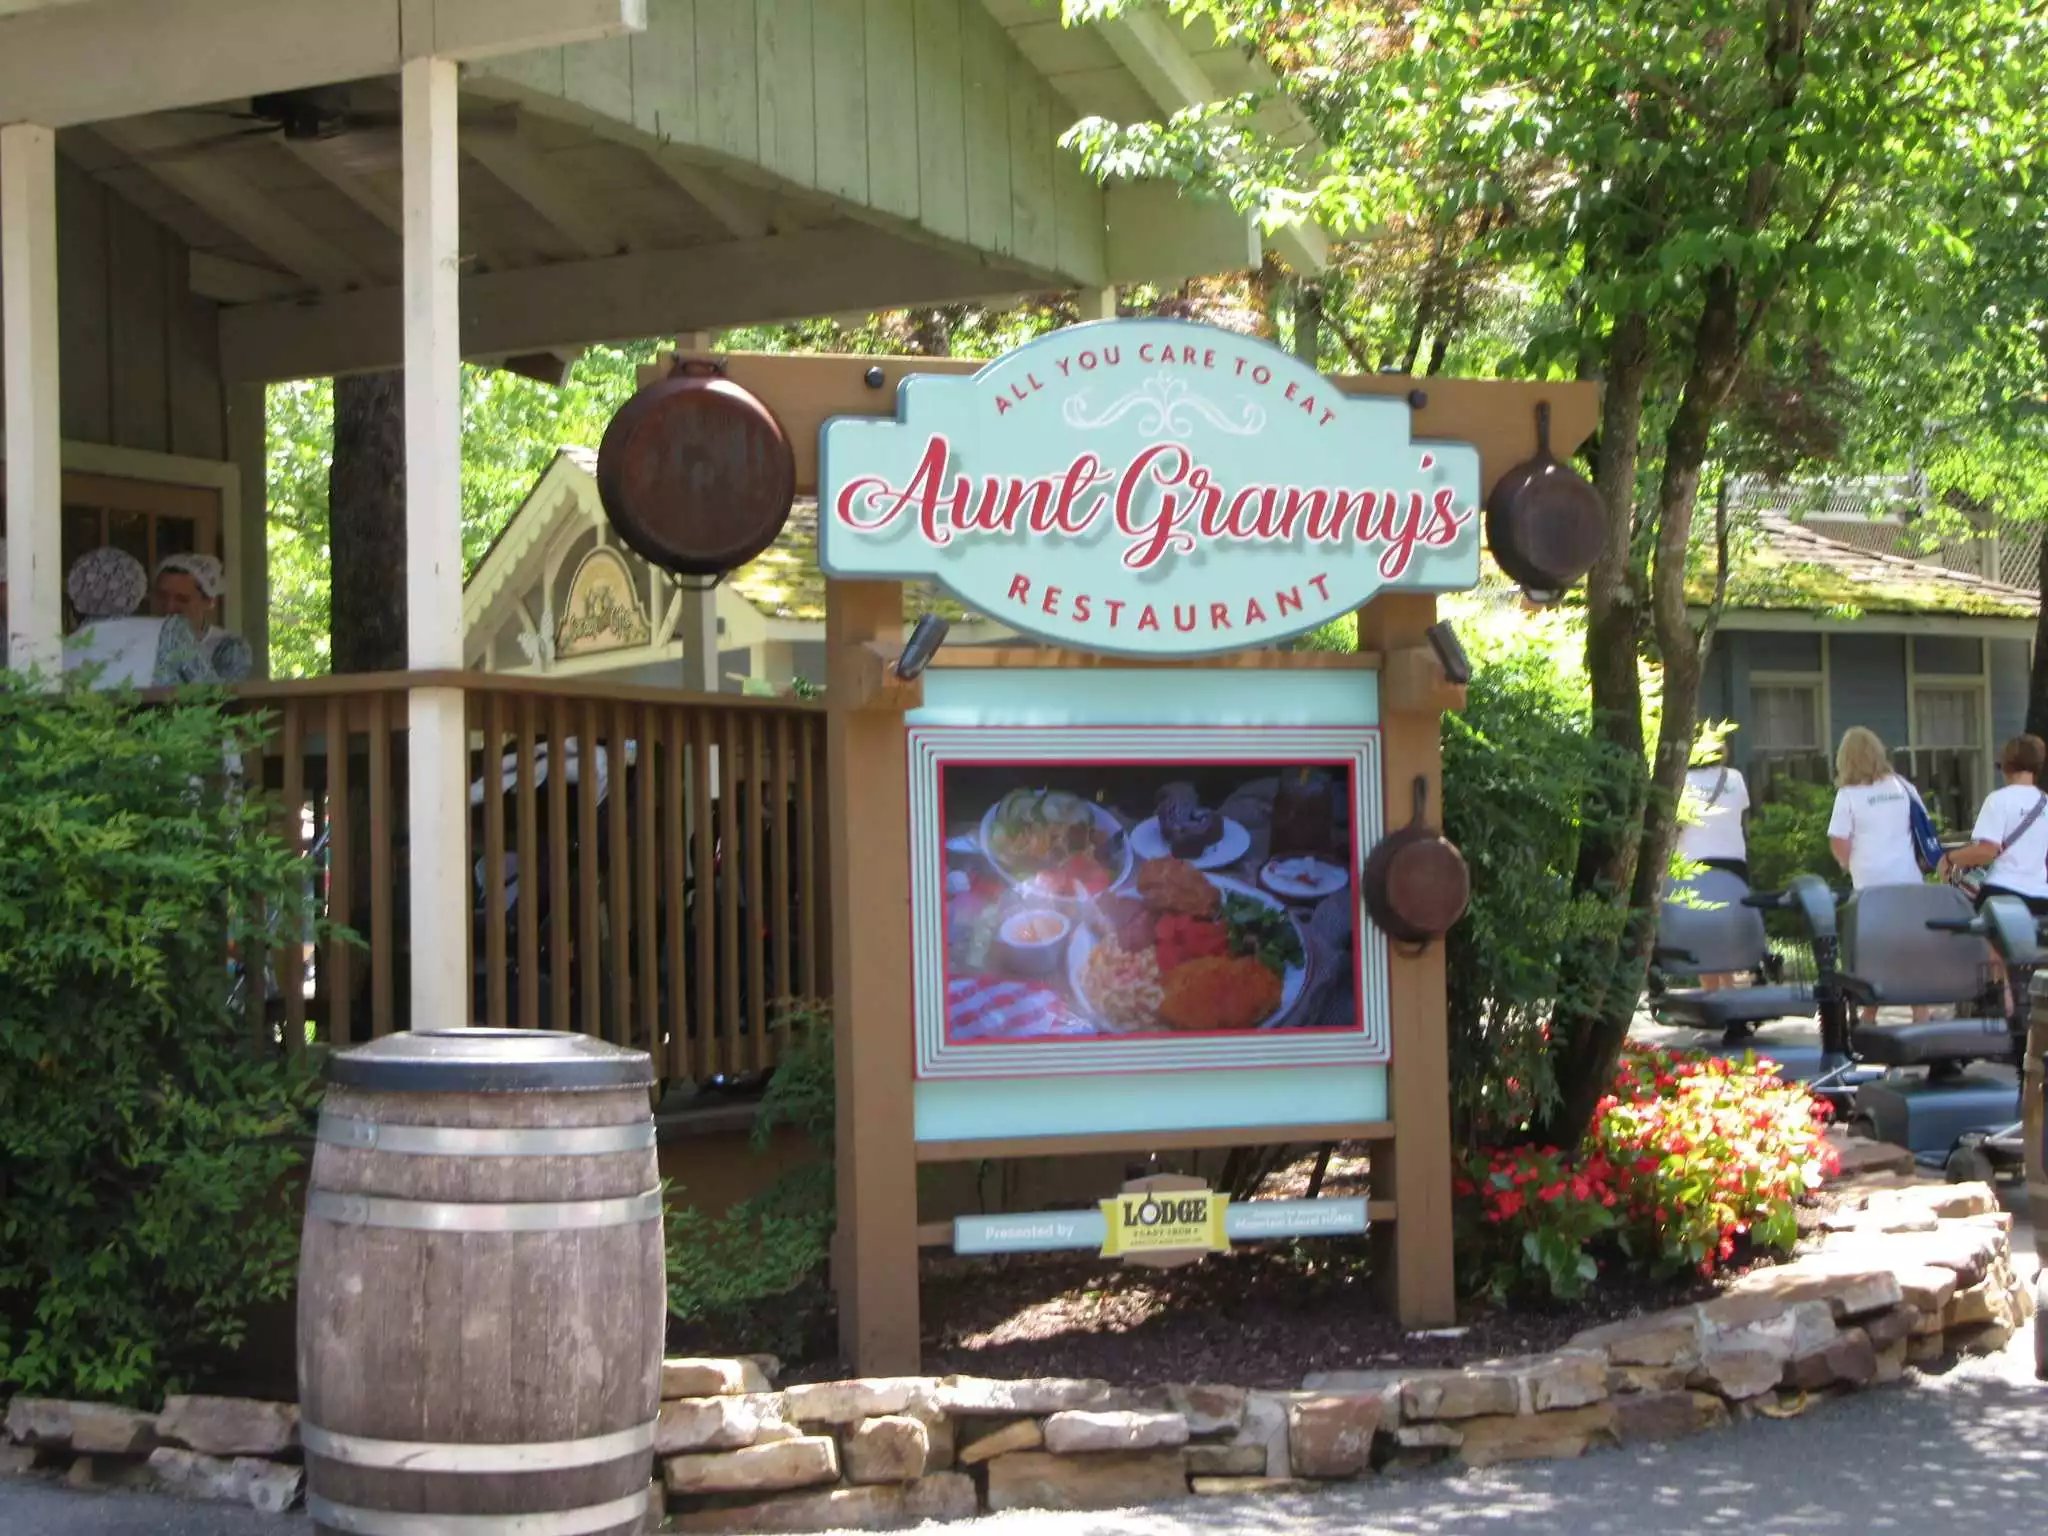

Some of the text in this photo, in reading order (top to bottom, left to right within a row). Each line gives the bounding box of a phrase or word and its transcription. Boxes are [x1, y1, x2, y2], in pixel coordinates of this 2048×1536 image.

[995, 342, 1336, 427] ALL YOU CARE TO EAT
[836, 434, 1472, 578] Aunt Granny's
[1008, 572, 1332, 633] RESTAURANT
[1123, 1199, 1207, 1227] LODGE
